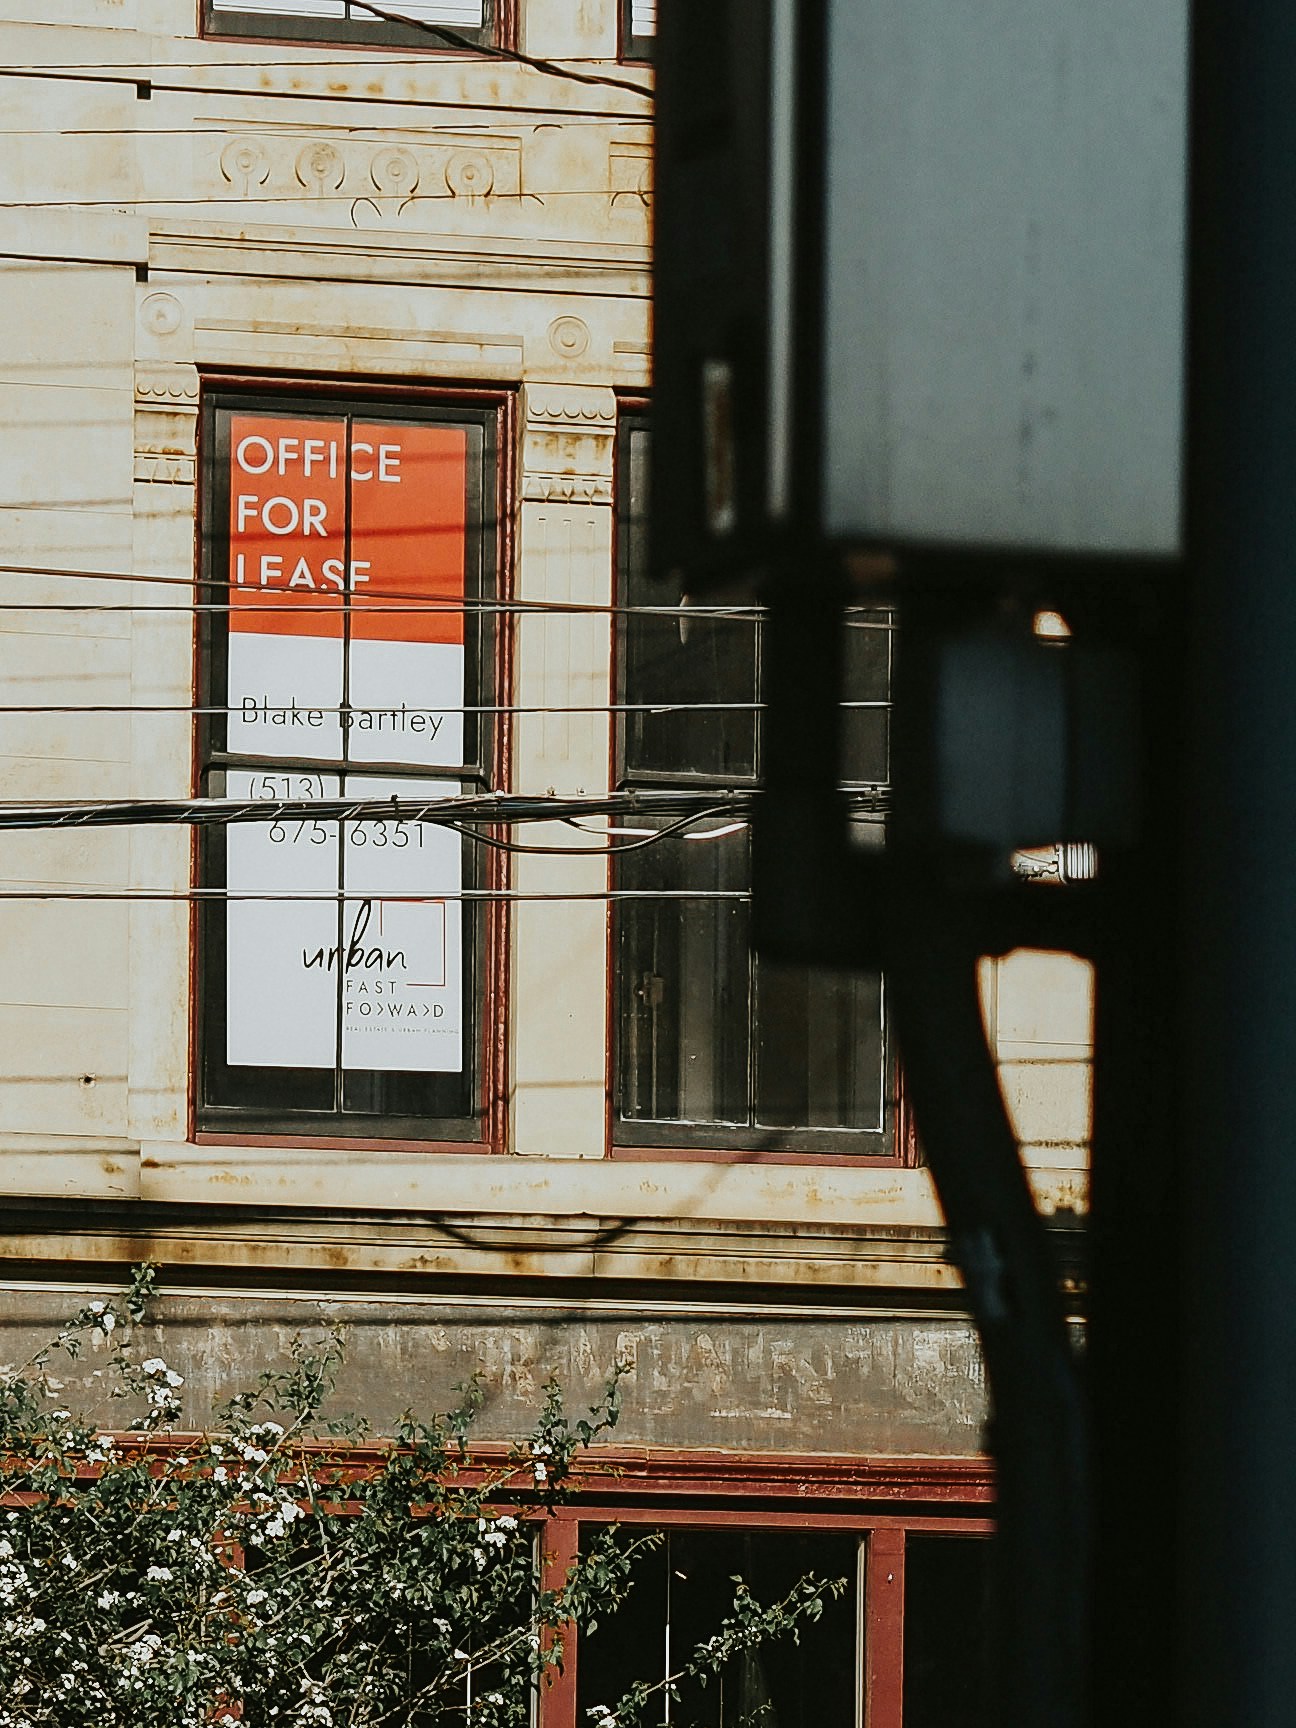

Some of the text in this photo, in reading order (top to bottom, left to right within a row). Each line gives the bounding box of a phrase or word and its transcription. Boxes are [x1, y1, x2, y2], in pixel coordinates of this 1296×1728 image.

[236, 435, 401, 483] OFFICE
[237, 494, 328, 537] FOR
[236, 553, 372, 598] LEASE
[241, 695, 324, 728] Blake
[303, 899, 407, 974] urban
[346, 980, 397, 995] FAST
